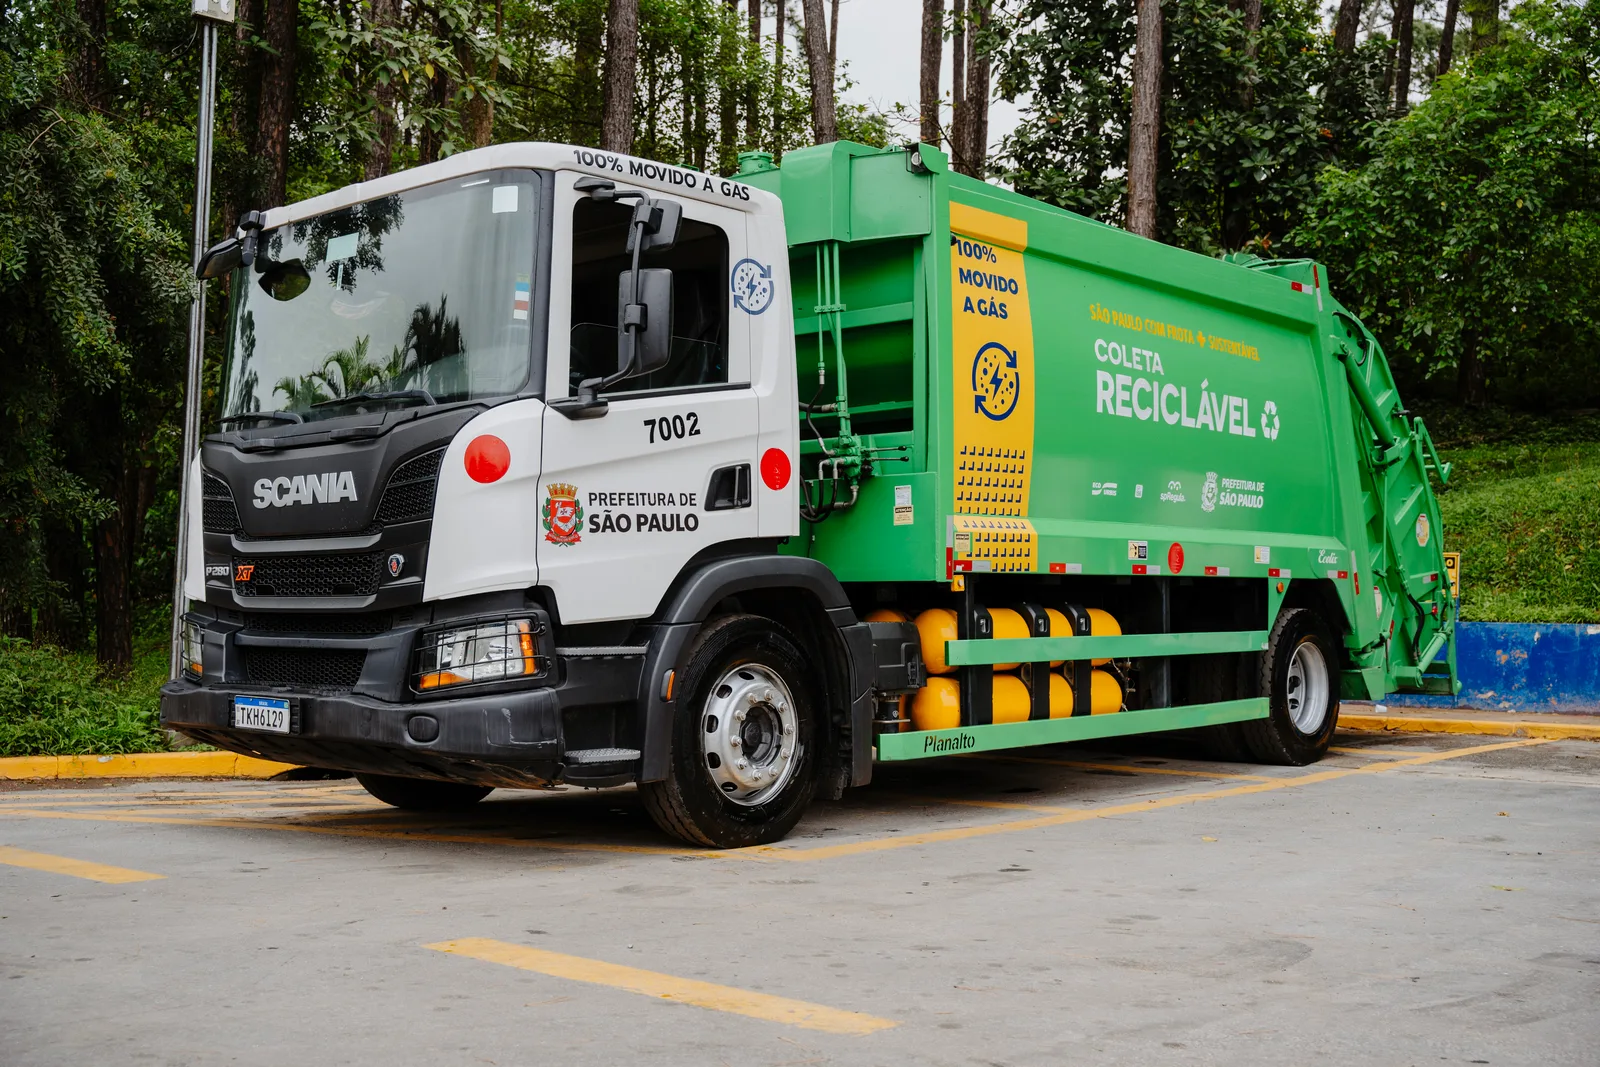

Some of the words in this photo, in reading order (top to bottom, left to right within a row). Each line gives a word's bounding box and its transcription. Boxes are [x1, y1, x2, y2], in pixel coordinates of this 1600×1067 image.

[573, 150, 624, 173] 100%
[628, 160, 697, 188] MOVIDO
[702, 177, 714, 193] A
[956, 239, 997, 263] 100%
[959, 267, 1019, 295] MOVIDO
[963, 296, 975, 314] A
[977, 296, 1008, 320] GÁS
[1089, 303, 1110, 324] SÃO
[1112, 310, 1142, 331] PAULO
[1144, 318, 1165, 337] COM
[1167, 324, 1195, 344] FROTA
[1208, 334, 1260, 361] SUSTENTÁVEL
[1094, 338, 1164, 375] COLETA
[1096, 370, 1256, 437] RECICLÁVEL
[643, 411, 701, 443] 7002
[252, 471, 357, 509] SCANIA
[1221, 478, 1255, 491] PREFEITURA
[1256, 482, 1265, 492] DE
[588, 492, 676, 507] PREFEITURA
[680, 492, 697, 506] DE
[1219, 489, 1237, 506] SÃO
[1237, 494, 1264, 508] PAULO
[588, 510, 632, 533] SÃO
[636, 513, 699, 532] PAULO
[235, 565, 255, 581] XT
[924, 732, 976, 753] Planalto
